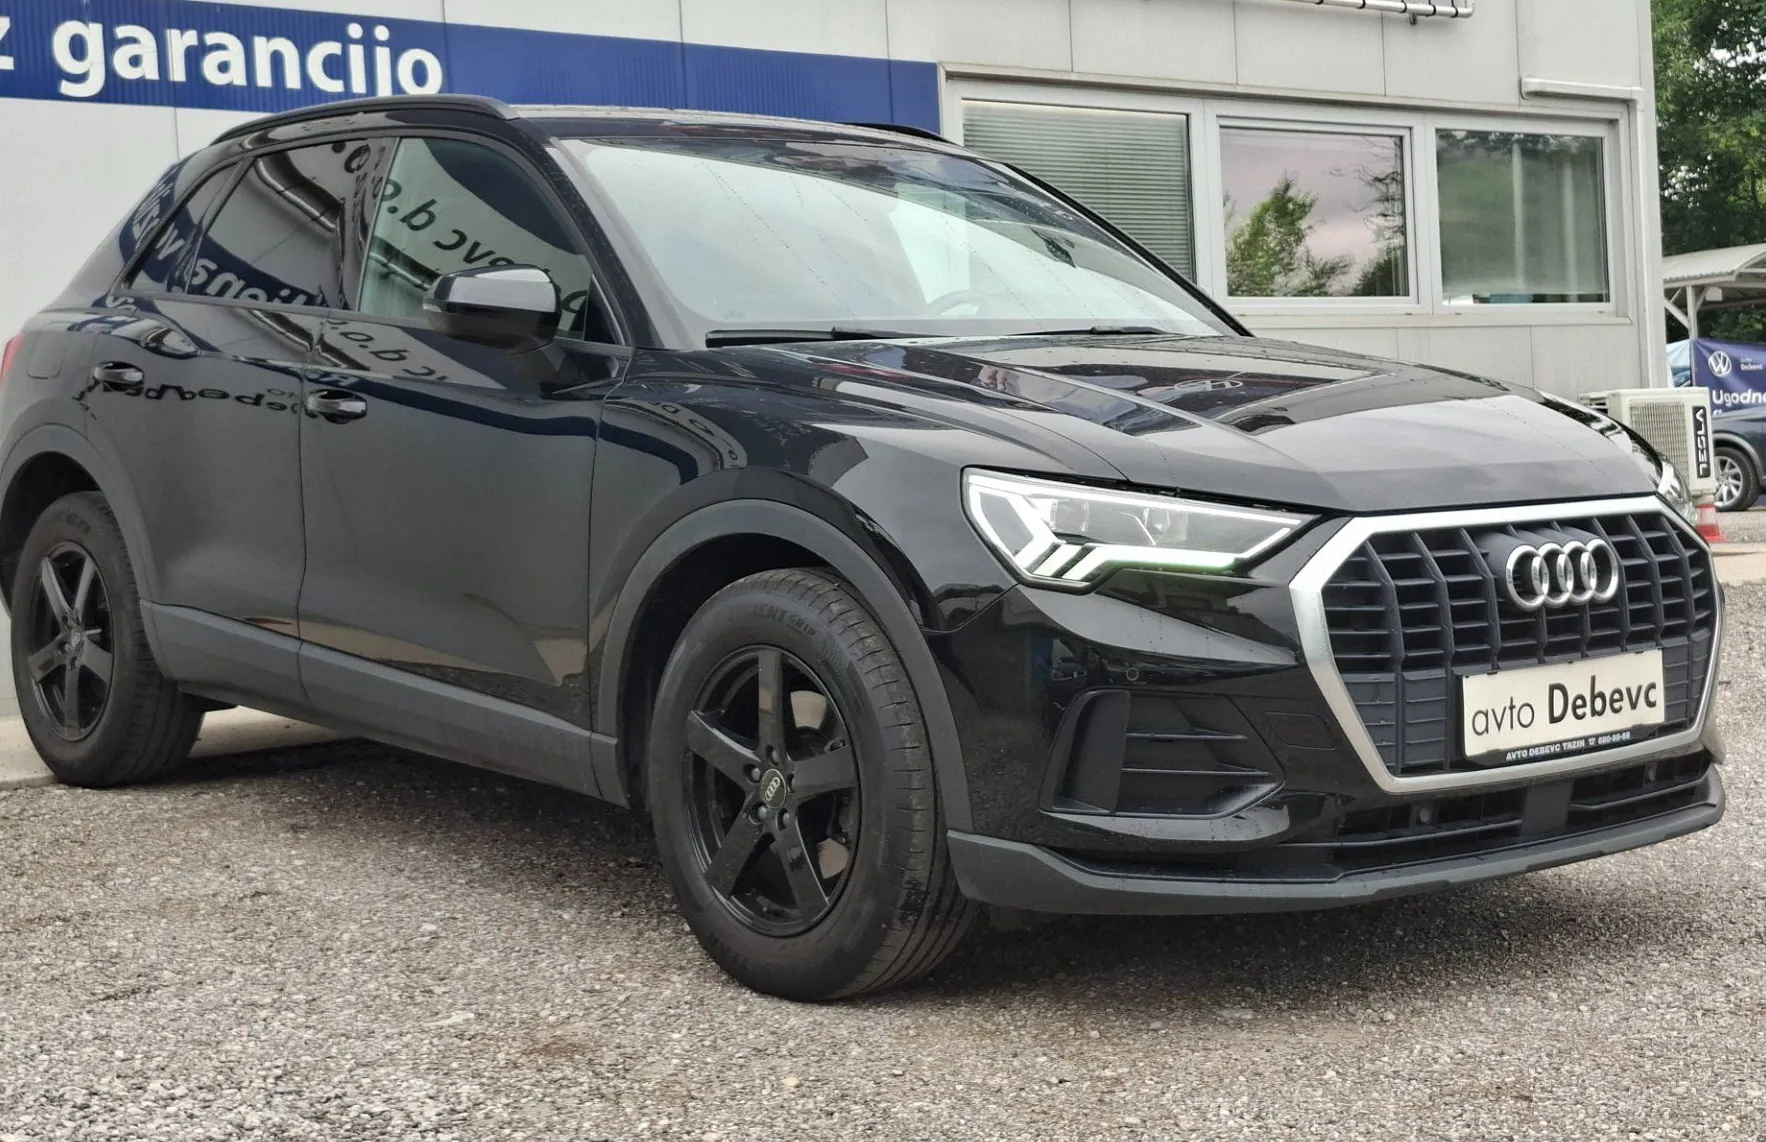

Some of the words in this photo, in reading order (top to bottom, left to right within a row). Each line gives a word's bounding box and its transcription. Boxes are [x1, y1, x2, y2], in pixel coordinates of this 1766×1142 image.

[53, 20, 443, 97] garancijo
[1472, 697, 1535, 736] avto
[1548, 675, 1657, 725] Debevc
[1505, 749, 1528, 761] AVTO
[1529, 743, 1561, 757] DEBEVC
